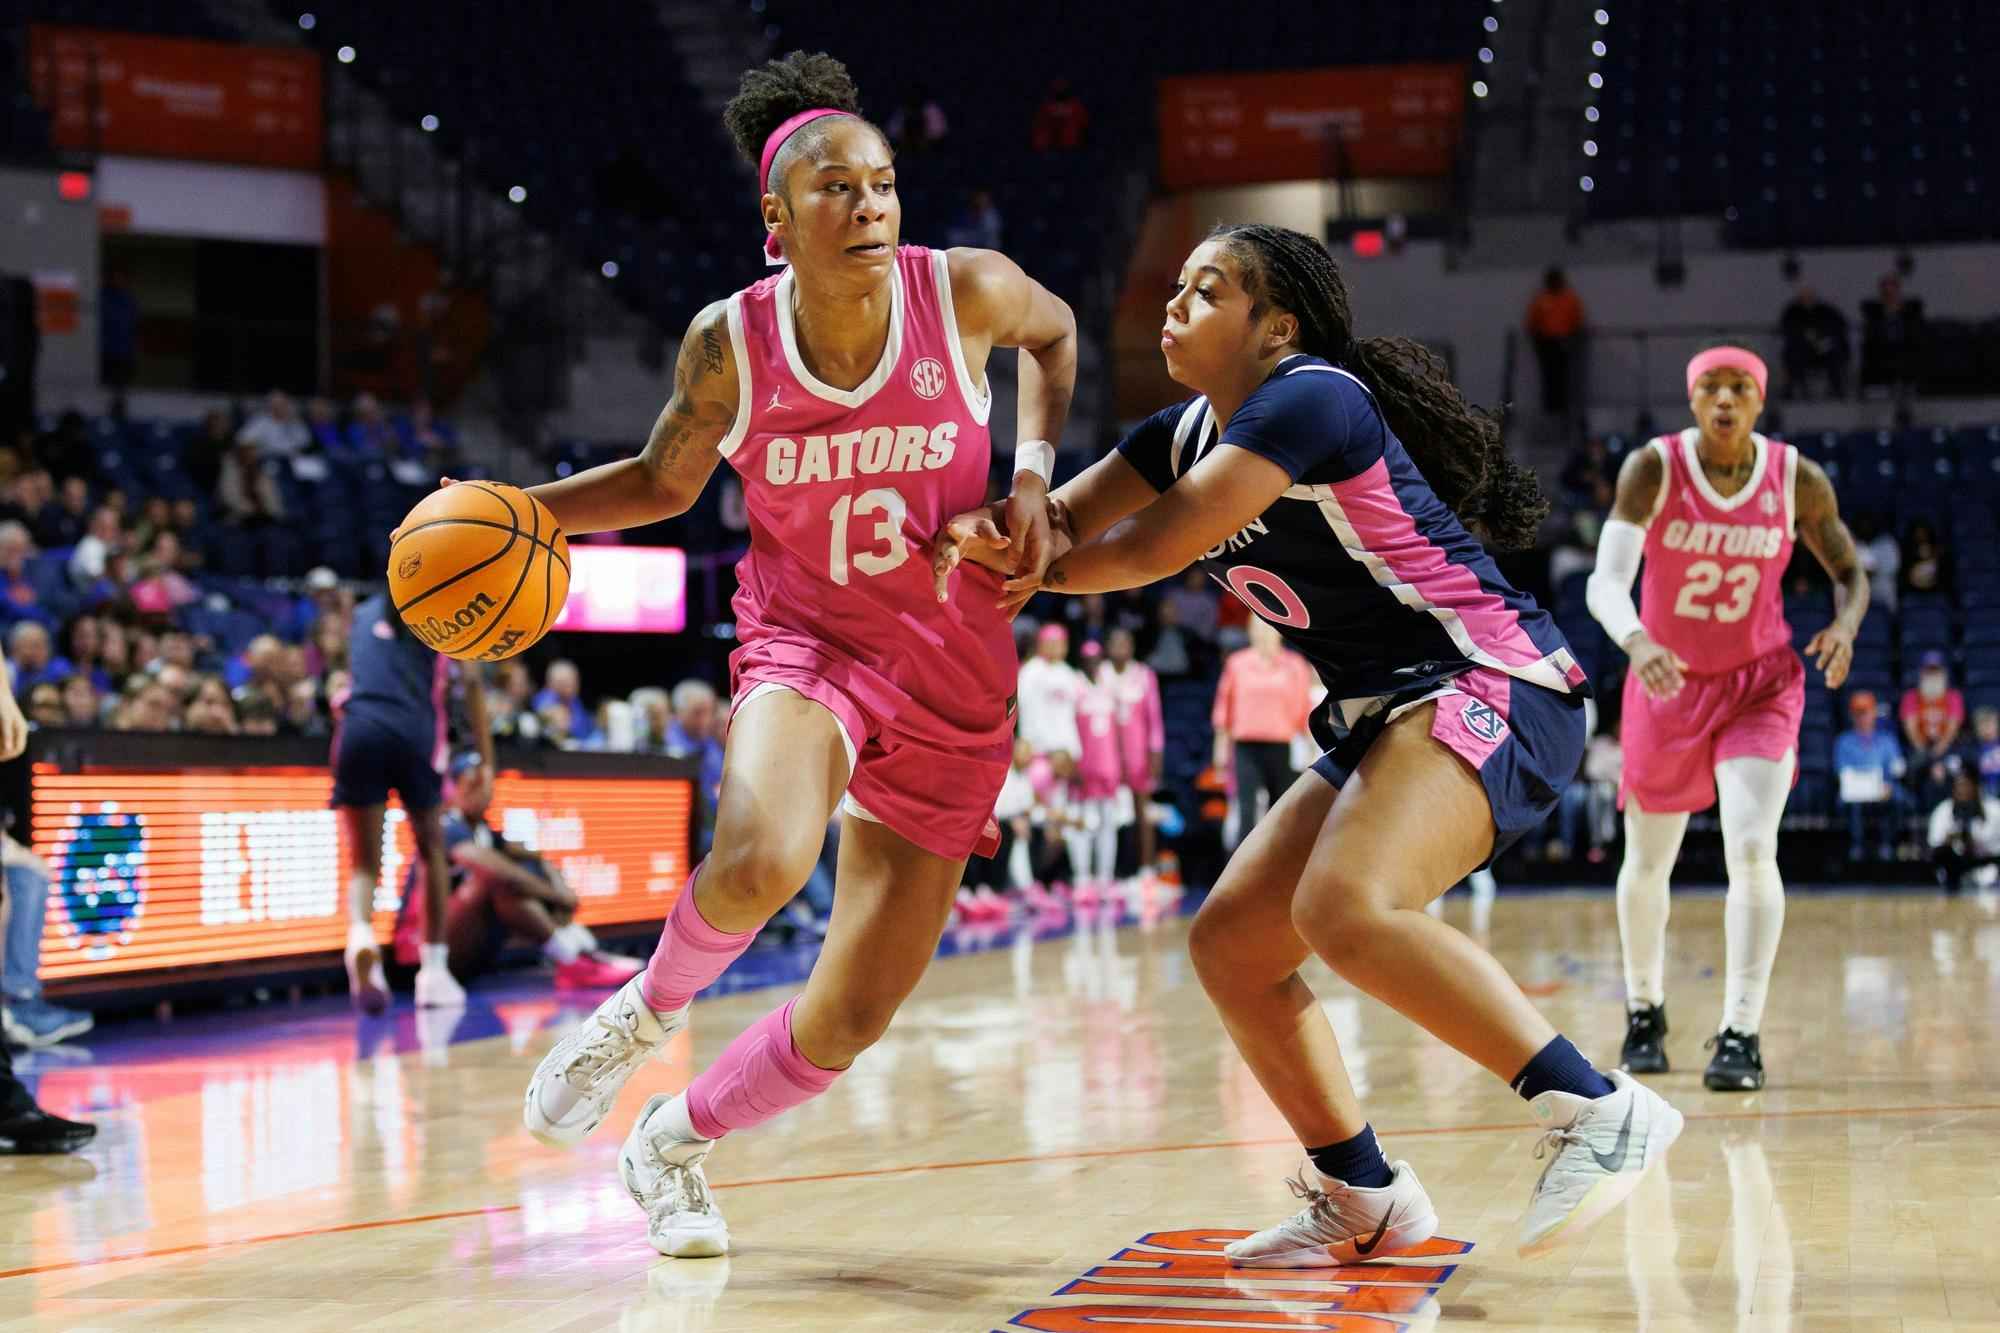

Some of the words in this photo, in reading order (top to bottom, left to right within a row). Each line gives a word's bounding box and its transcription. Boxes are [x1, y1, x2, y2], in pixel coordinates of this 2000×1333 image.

[911, 362, 946, 397] SEC
[765, 421, 959, 486] GATORS
[828, 486, 910, 586] 13
[1661, 518, 1784, 560] GATORS
[1208, 565, 1311, 630] 0
[1673, 559, 1761, 624] 23
